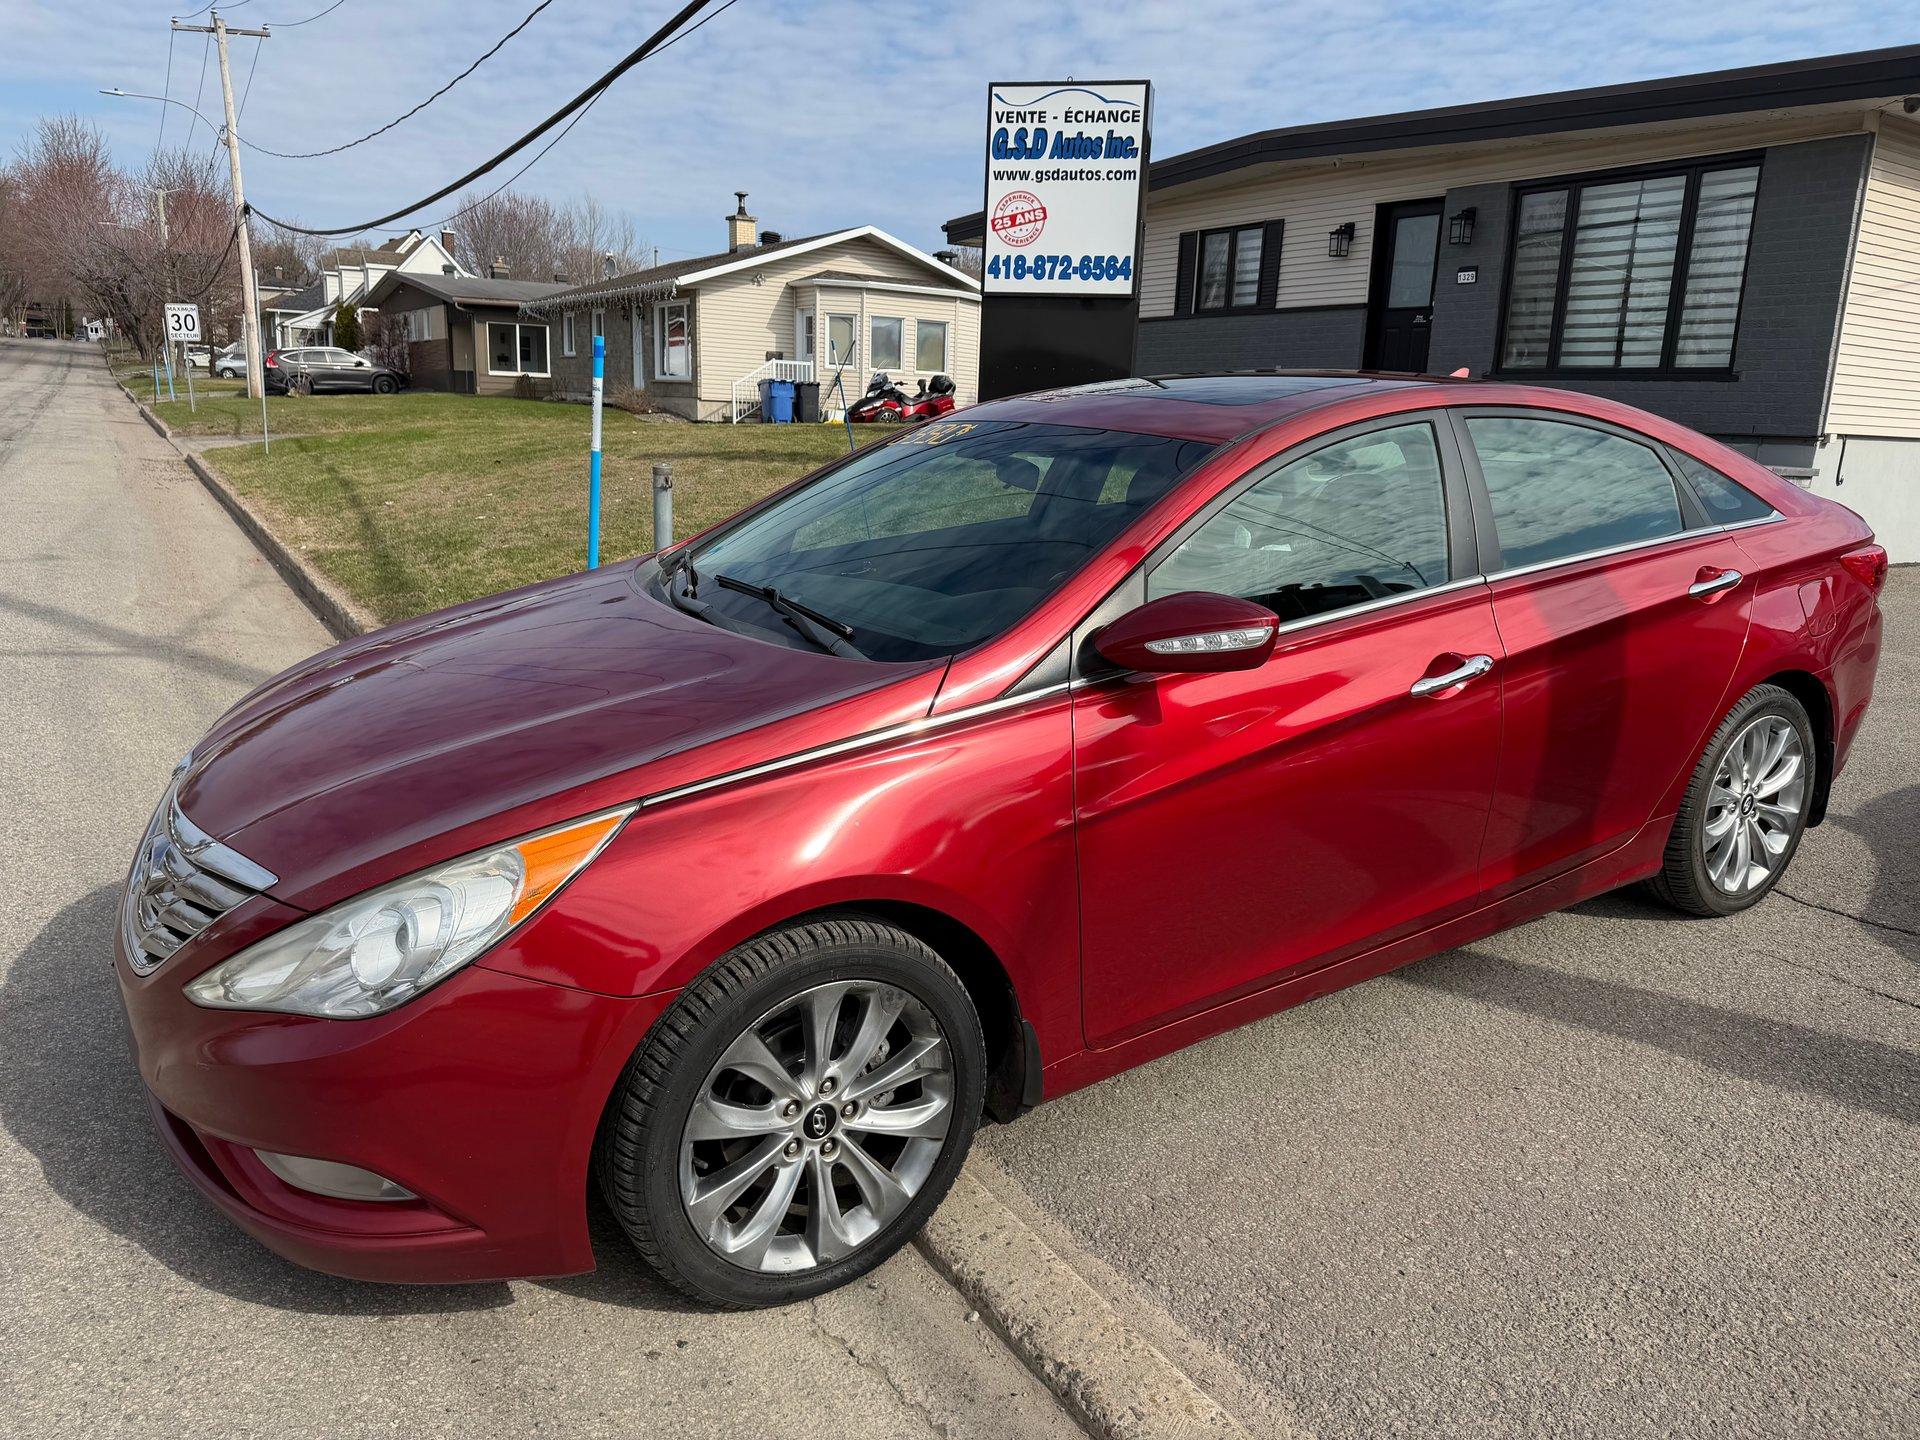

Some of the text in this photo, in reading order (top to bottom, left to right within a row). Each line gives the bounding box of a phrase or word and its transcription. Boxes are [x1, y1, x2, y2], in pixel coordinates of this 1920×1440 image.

[995, 111, 1047, 123] VENTE
[1064, 107, 1141, 123] ÉCHANGE
[992, 127, 1048, 160] G.S.D
[1049, 131, 1104, 159] Autos
[993, 168, 1137, 183] www.gsdautos.com
[994, 209, 1045, 229] 25 ANS
[988, 254, 1132, 281] 418-872-6564
[171, 314, 195, 331] 30
